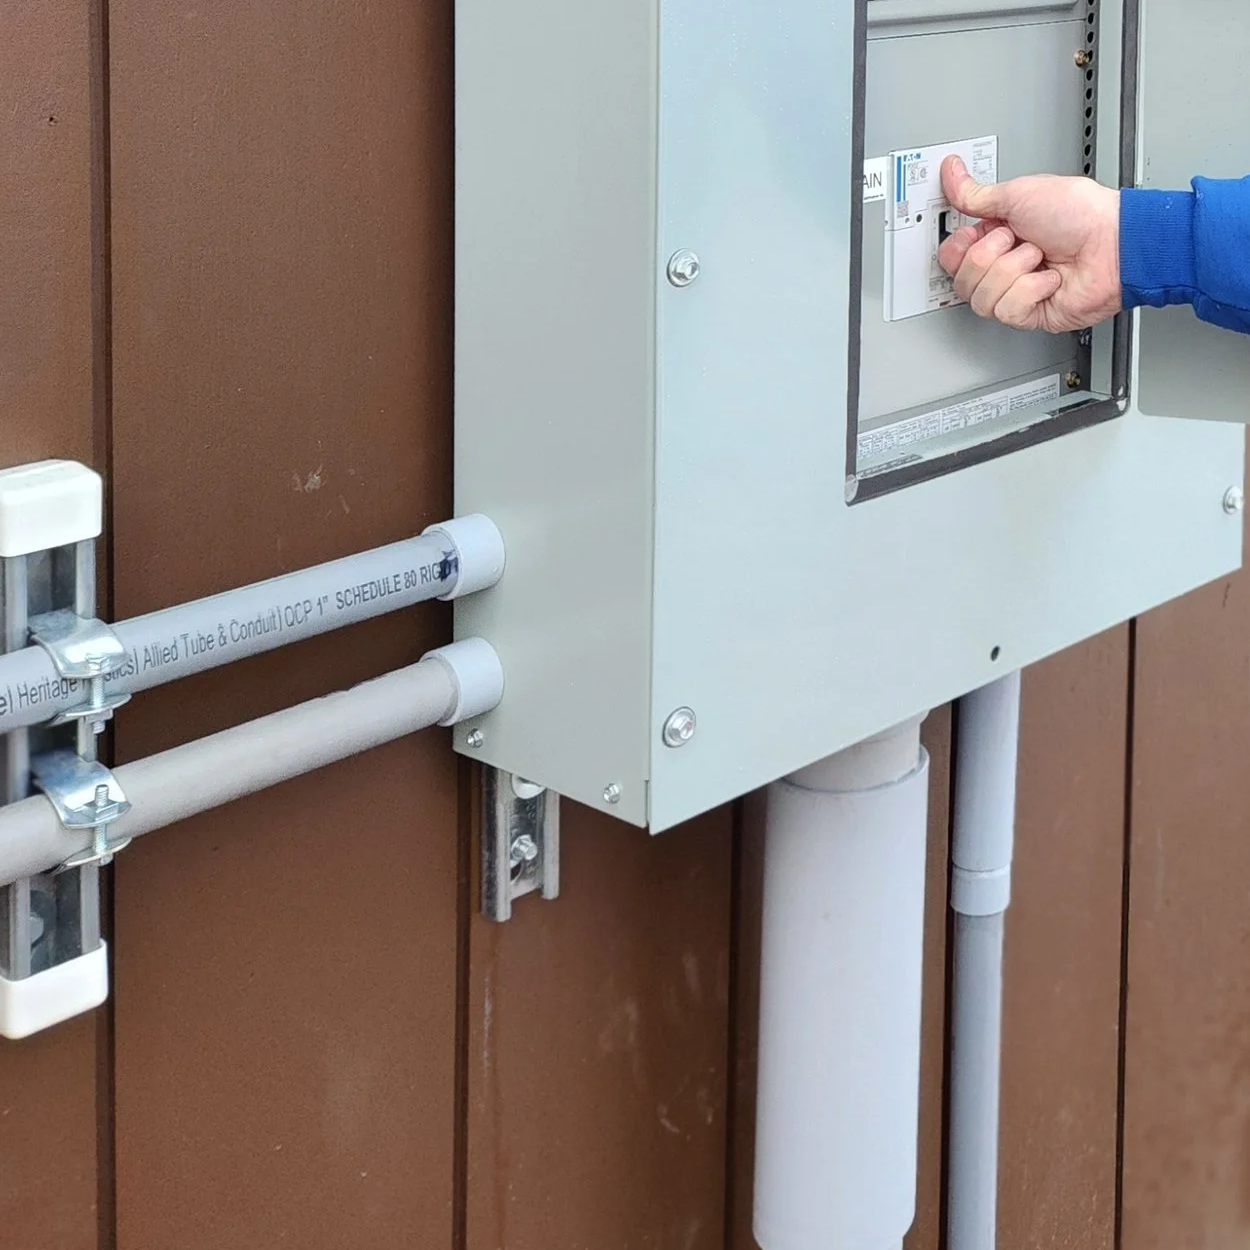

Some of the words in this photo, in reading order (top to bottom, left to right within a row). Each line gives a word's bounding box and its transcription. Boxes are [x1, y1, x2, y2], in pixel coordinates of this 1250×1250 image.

[863, 171, 882, 189] AIN
[143, 637, 178, 670] Allied
[180, 631, 214, 658] Tube
[217, 623, 227, 647] &
[336, 574, 400, 610] SCHEDULE
[404, 570, 417, 589] 80
